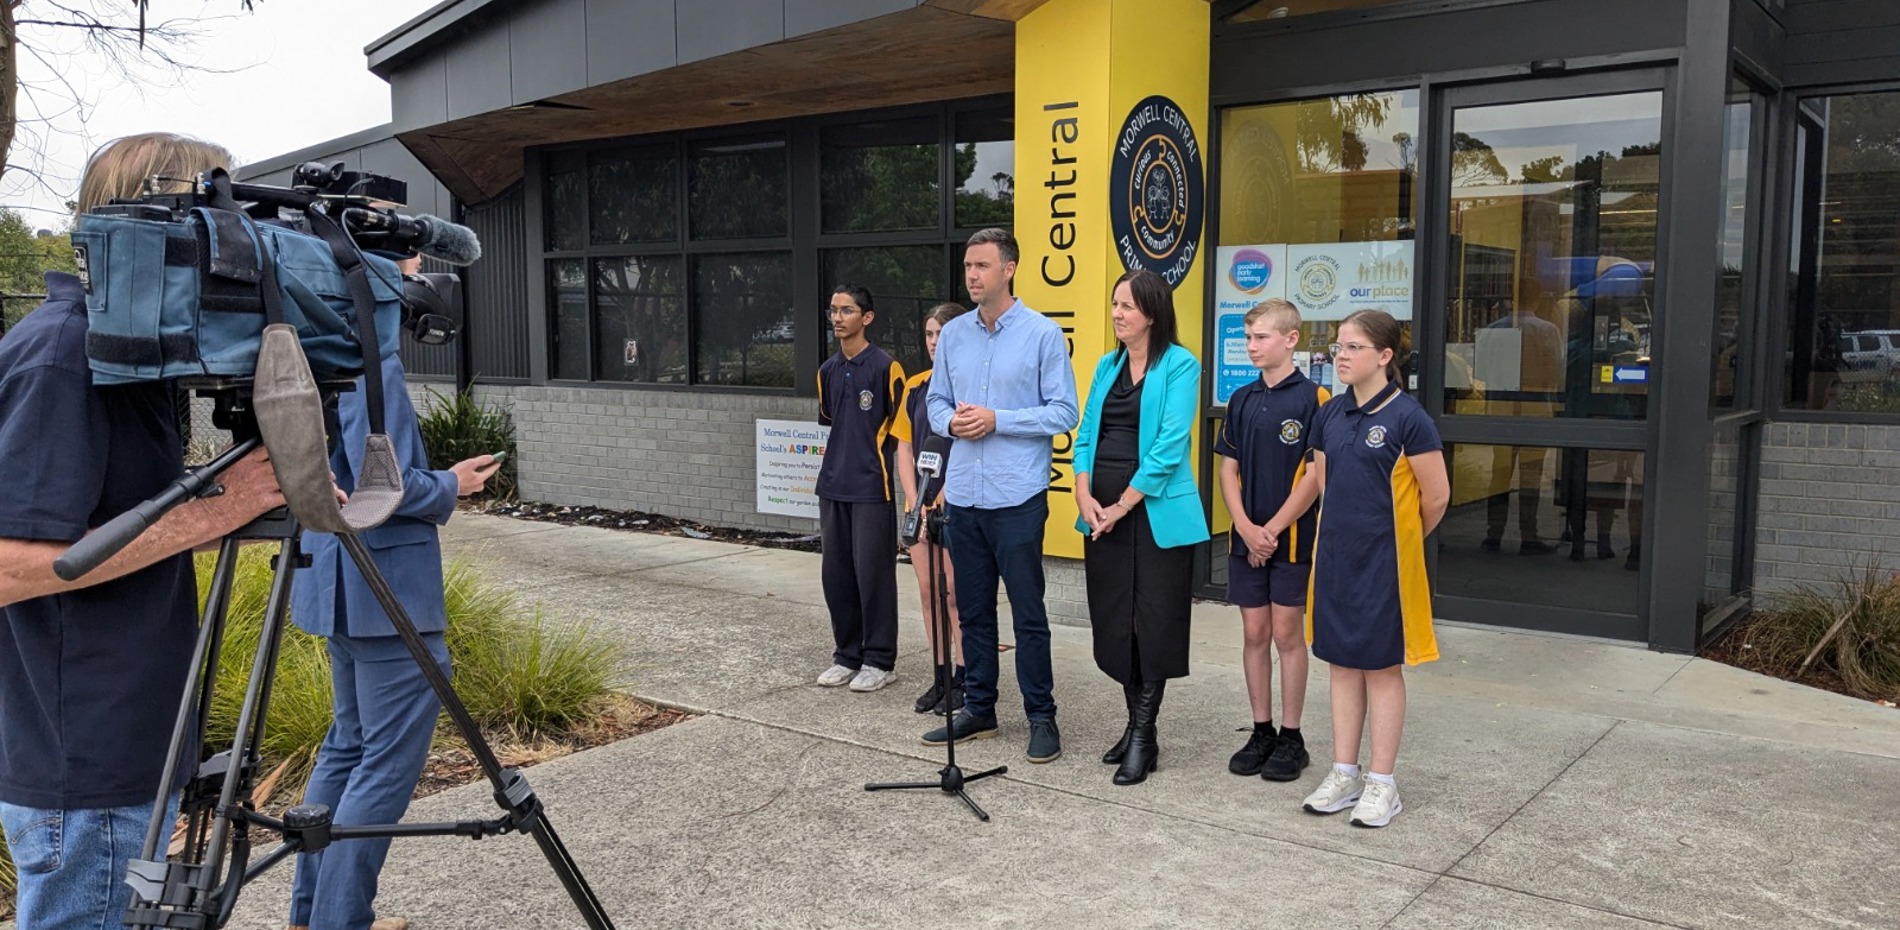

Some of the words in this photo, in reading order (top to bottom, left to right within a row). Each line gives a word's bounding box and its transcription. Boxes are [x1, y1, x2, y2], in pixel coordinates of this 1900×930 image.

[1120, 104, 1160, 159] MORWELL
[1163, 105, 1197, 163] CENTRAL
[1134, 149, 1151, 190] curious
[1167, 151, 1185, 208] connected
[1041, 101, 1079, 287] Central
[1141, 225, 1174, 250] community
[1120, 234, 1147, 271] PRIM
[1350, 287, 1371, 297] our
[1373, 285, 1409, 299] place
[1219, 301, 1250, 309] Morwell
[764, 427, 792, 438] Morwell
[793, 429, 819, 440] Central
[761, 443, 787, 453] School's
[789, 443, 824, 455] ASPIRE
[768, 495, 788, 504] Respect
